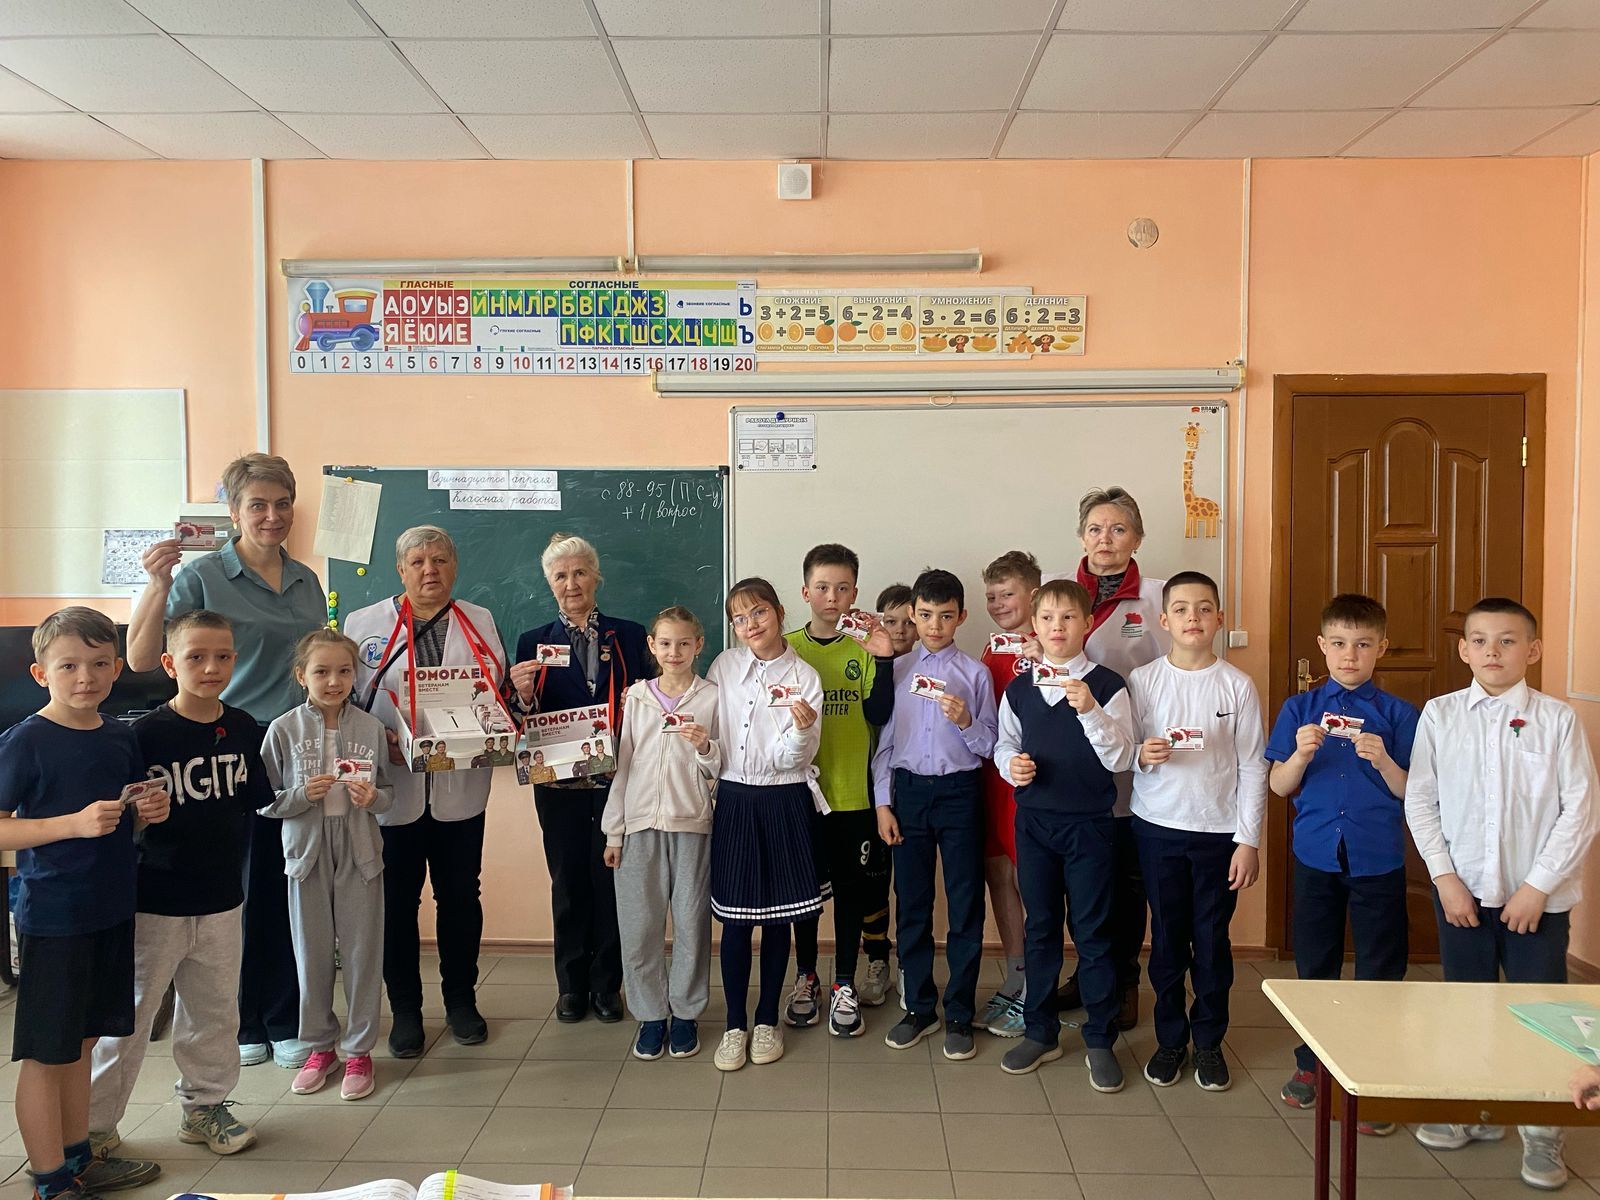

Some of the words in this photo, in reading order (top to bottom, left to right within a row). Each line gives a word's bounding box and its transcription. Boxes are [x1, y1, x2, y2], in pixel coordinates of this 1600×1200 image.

[931, 297, 992, 305] УМНОЖЕНИЕ
[1025, 297, 1068, 306] ДЕЛЕНИЕ
[298, 357, 306, 369] 0
[320, 357, 327, 369] 1
[341, 357, 350, 369] 2
[363, 357, 372, 369] 3
[385, 357, 394, 369] 4
[407, 357, 415, 369] 5
[429, 357, 437, 369] 6
[451, 357, 459, 369] 7
[474, 357, 482, 369] 8
[496, 357, 504, 369] 9
[514, 357, 530, 369] 10
[536, 358, 551, 370] 11
[558, 358, 574, 370] 12
[580, 358, 597, 370] 13
[602, 358, 619, 370] 14
[624, 358, 641, 370] 15
[646, 358, 663, 370] 16
[669, 358, 685, 370] 17
[691, 358, 707, 370] 18
[713, 358, 730, 370] 19
[735, 358, 752, 370] 20
[432, 471, 505, 487] Одиннадцатое
[512, 473, 552, 487] апреля
[452, 490, 505, 503] Классная
[822, 703, 848, 715] ETTER
[527, 707, 608, 729] ПОМОГАЕМ
[541, 725, 570, 733] ВЕТЕРАНАМ
[860, 840, 871, 866] 9
